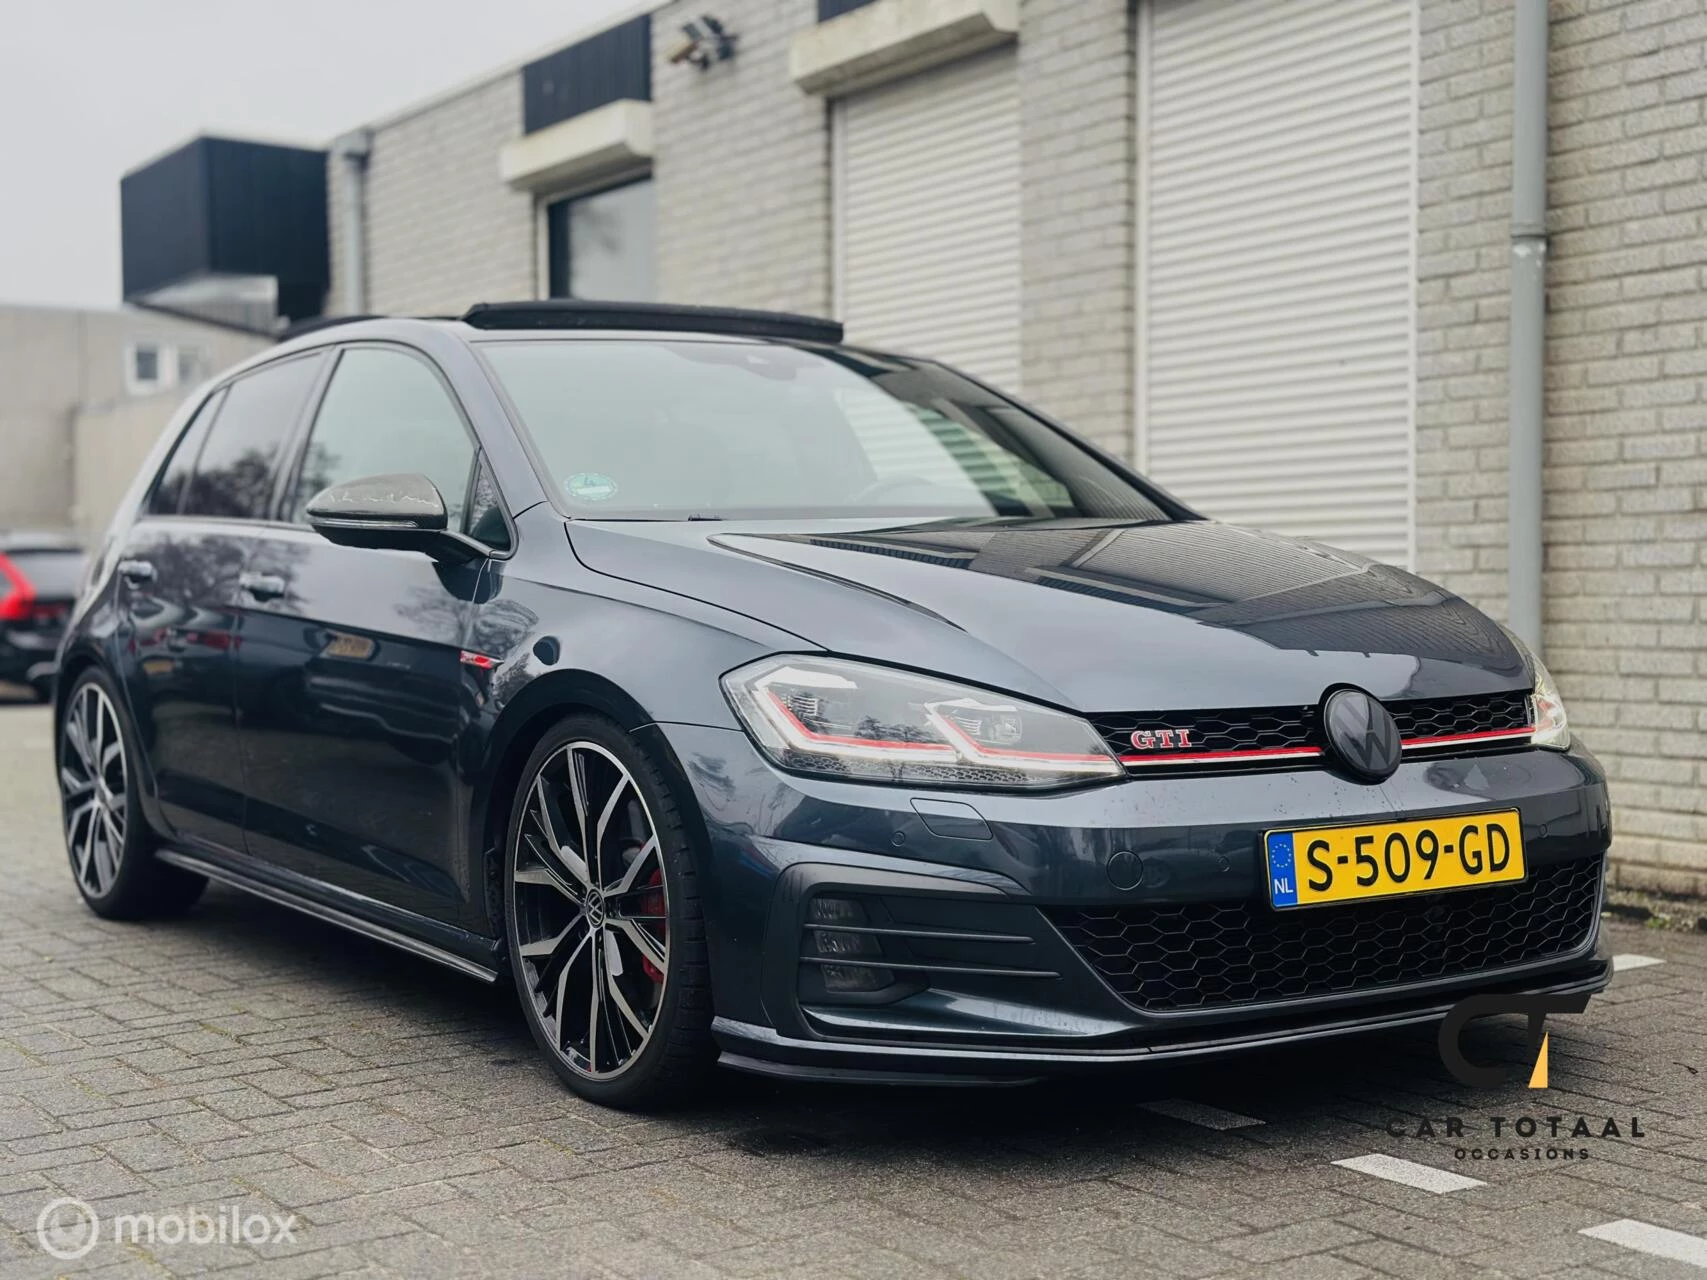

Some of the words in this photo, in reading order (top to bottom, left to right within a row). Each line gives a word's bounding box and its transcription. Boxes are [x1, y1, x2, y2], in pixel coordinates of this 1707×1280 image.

[1130, 728, 1193, 750] GTI
[1306, 823, 1511, 892] S-509-GD
[1274, 878, 1294, 895] NL
